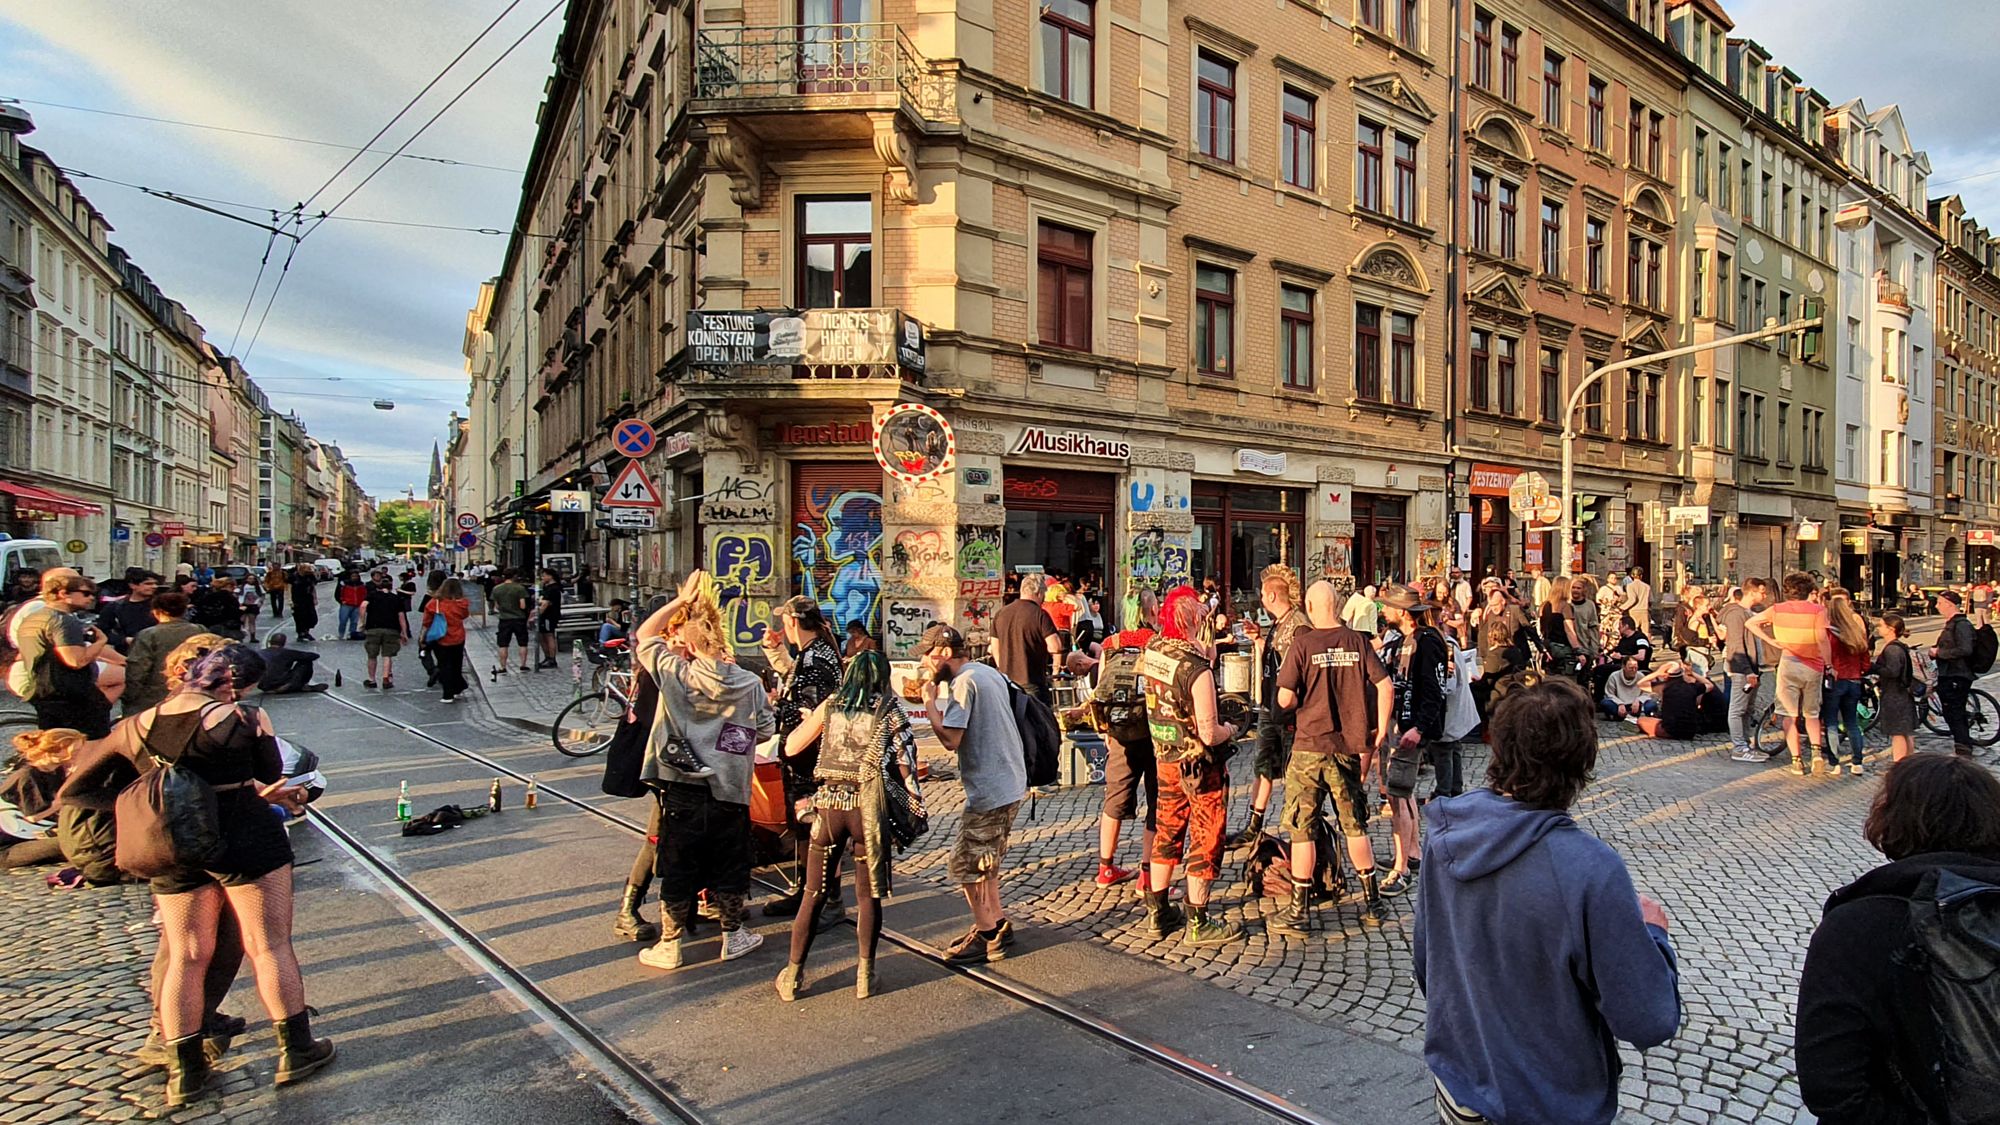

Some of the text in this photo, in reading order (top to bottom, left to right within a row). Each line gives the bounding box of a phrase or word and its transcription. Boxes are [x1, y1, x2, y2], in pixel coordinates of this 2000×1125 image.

[703, 315, 755, 331] FESTUNG
[821, 312, 869, 330] TICKETS
[687, 328, 756, 346] KÖNIGSTEIN
[821, 329, 850, 346] HIER
[855, 329, 869, 345] IM
[695, 346, 729, 362] OPEN
[734, 346, 755, 362] AIR
[821, 345, 862, 361] LADEN
[1017, 428, 1131, 459] Musikhaus
[461, 517, 475, 526] 30
[890, 601, 931, 621] Gegen
